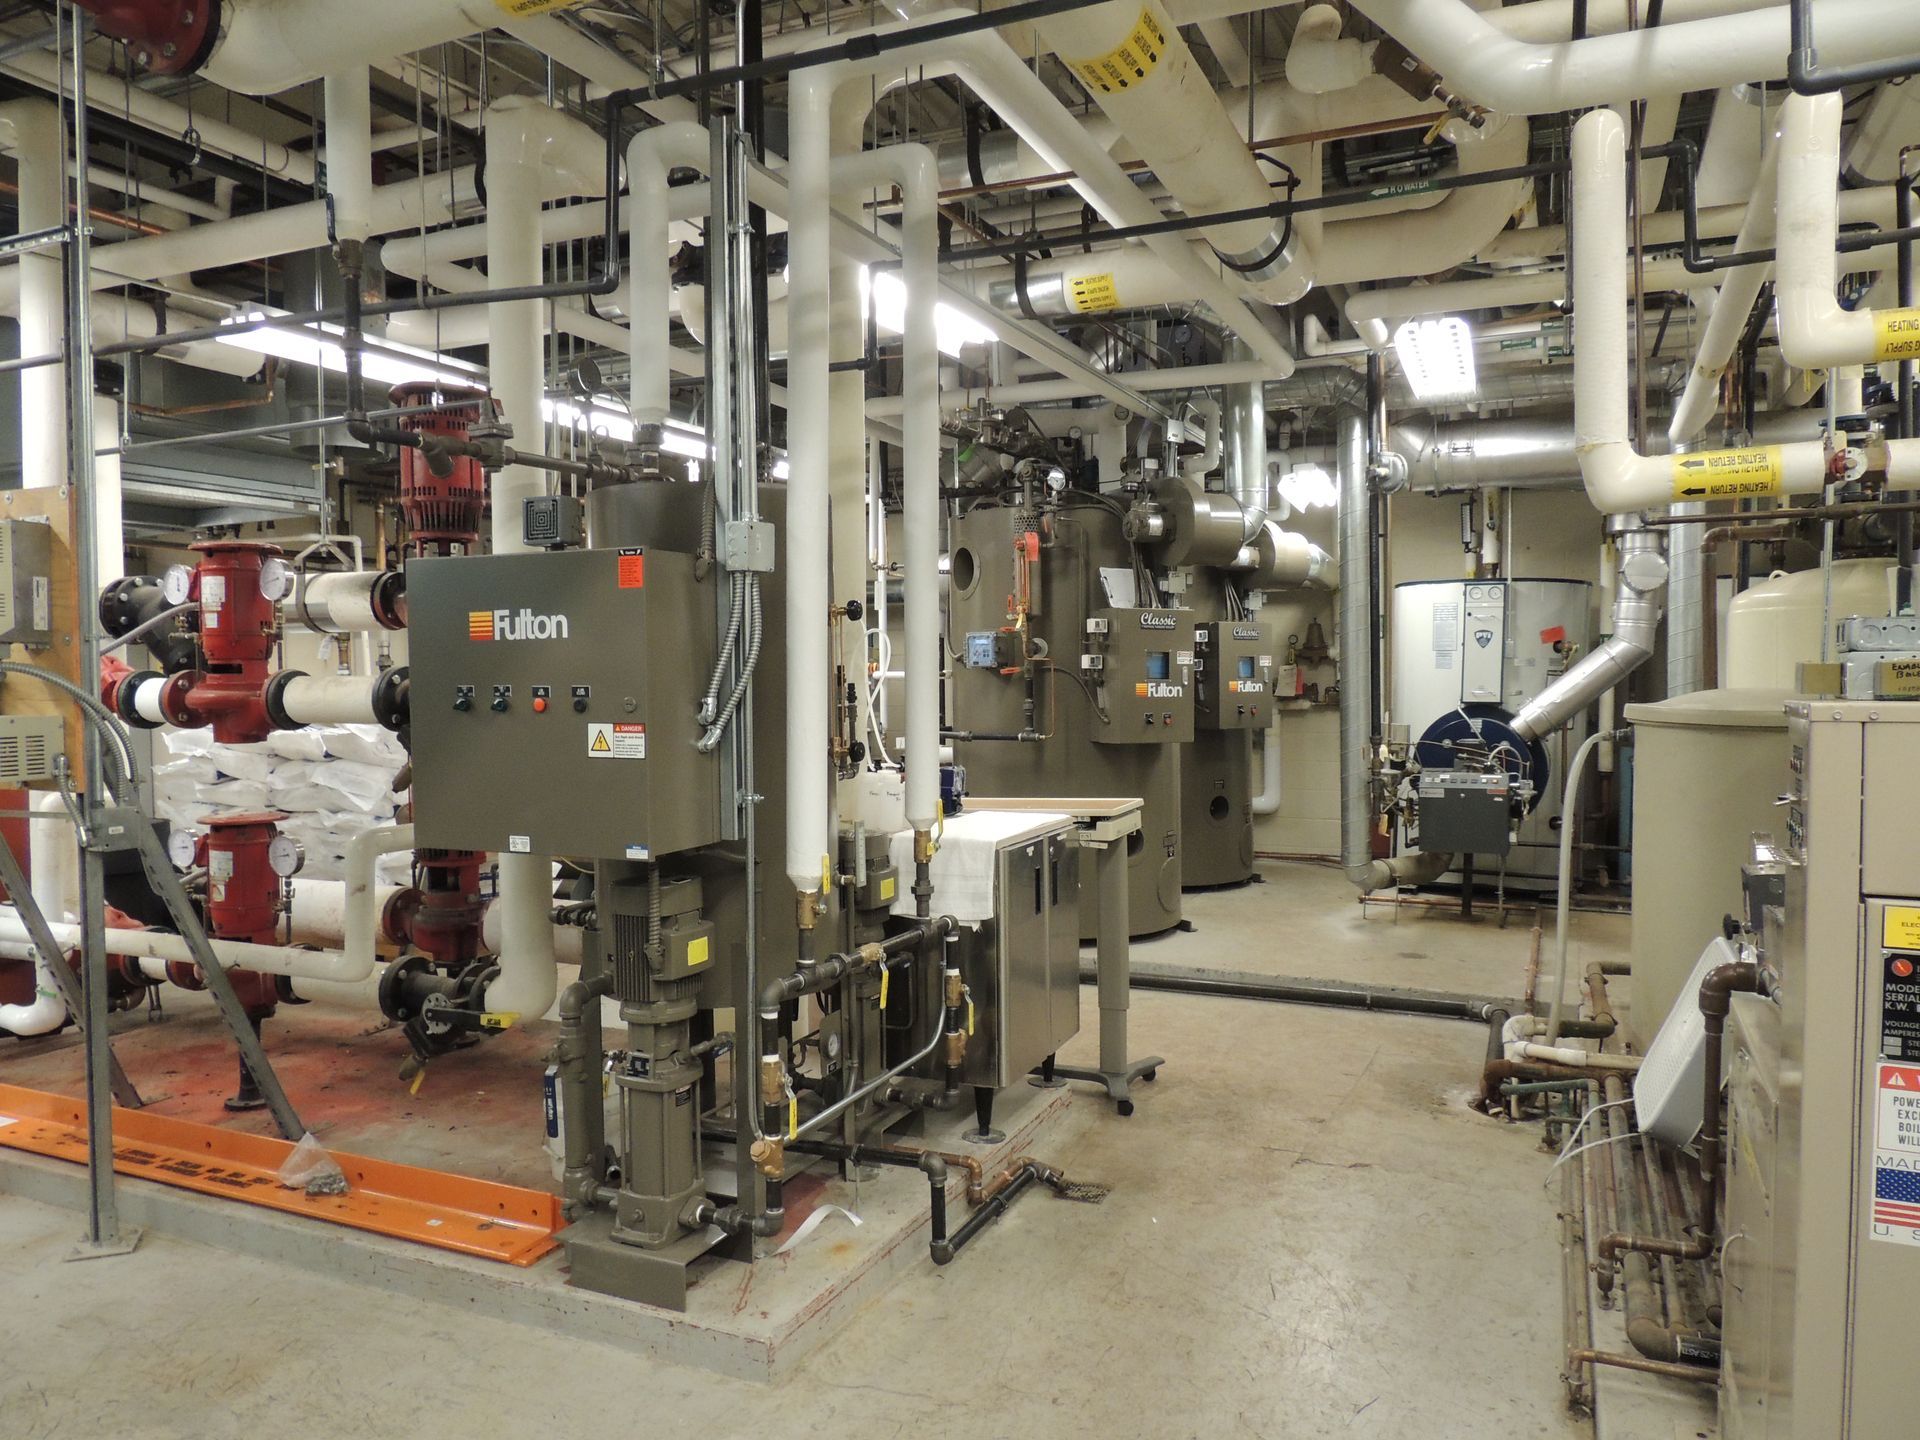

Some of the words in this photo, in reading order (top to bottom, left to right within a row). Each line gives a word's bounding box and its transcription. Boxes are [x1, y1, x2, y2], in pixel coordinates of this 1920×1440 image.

[1404, 180, 1429, 191] WATER
[1887, 319, 1919, 332] HEATING
[1884, 341, 1913, 353] SUPPLY
[1708, 456, 1736, 467] RETURN
[1737, 453, 1767, 465] HEATING
[1710, 483, 1738, 494] RETURN
[1739, 482, 1769, 493] HEATING
[493, 608, 569, 640] Fulton
[1140, 612, 1177, 625] Classic
[1233, 626, 1260, 636] Classic
[1148, 682, 1183, 697] Fulton
[1237, 680, 1263, 692] Fulton
[1886, 984, 1920, 993] MODE
[1885, 992, 1920, 1003] SERIAL
[1885, 1002, 1910, 1011] K.W.
[1885, 1021, 1920, 1029] VOLTAGE
[1884, 1029, 1920, 1038] AMPERES
[1893, 1096, 1920, 1108] POWE
[1898, 1110, 1920, 1121] EXC
